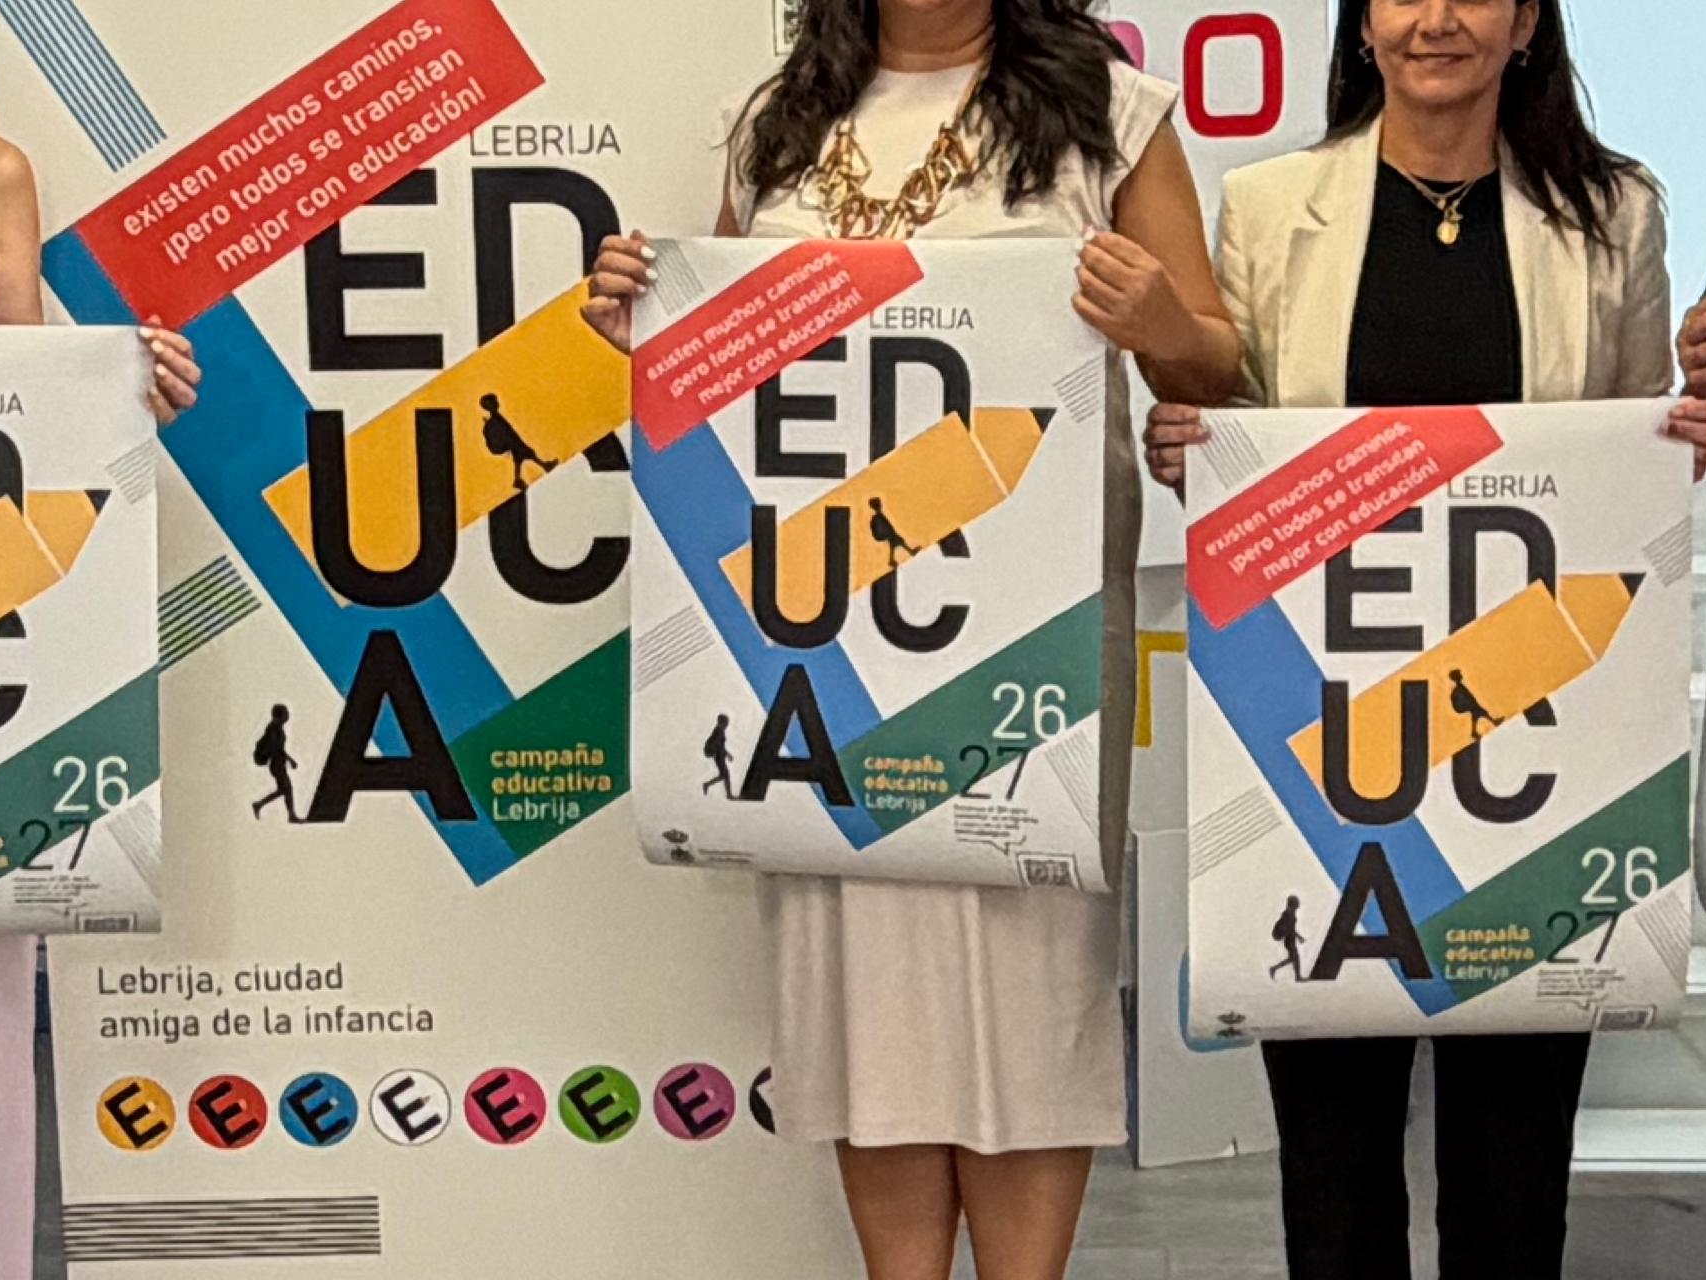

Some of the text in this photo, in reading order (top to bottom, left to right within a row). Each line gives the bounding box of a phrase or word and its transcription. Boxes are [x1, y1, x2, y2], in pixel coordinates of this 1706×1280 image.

[123, 17, 443, 237] existen muchos caminos,
[470, 124, 621, 156] LEBRIJA
[164, 48, 465, 266] ¡pero todos se transitan
[215, 77, 486, 272] mejor con educación!
[704, 296, 766, 341] muchos
[869, 306, 975, 329] LEBRIJA
[746, 348, 777, 373] con
[1267, 466, 1334, 516] muchos
[1447, 474, 1557, 498] LEBRIJA
[1314, 521, 1345, 546] con
[993, 682, 1067, 742] 26
[490, 743, 605, 770] campaña
[863, 754, 945, 774] campaña
[959, 745, 1032, 800] 27
[53, 756, 130, 813] 26
[491, 772, 612, 794] educativa
[864, 775, 949, 793] educativa
[493, 797, 580, 824] Lebrija
[865, 795, 927, 814] Lebrija
[19, 819, 93, 870] 27
[1581, 846, 1658, 903] 26
[1446, 924, 1530, 943] campaña
[1546, 911, 1621, 963] 27
[1446, 946, 1535, 962] educativa
[98, 962, 343, 1000] Lebrija, ciudad
[1445, 965, 1509, 981] Lebrija
[100, 1003, 435, 1044] amiga de la infancia
